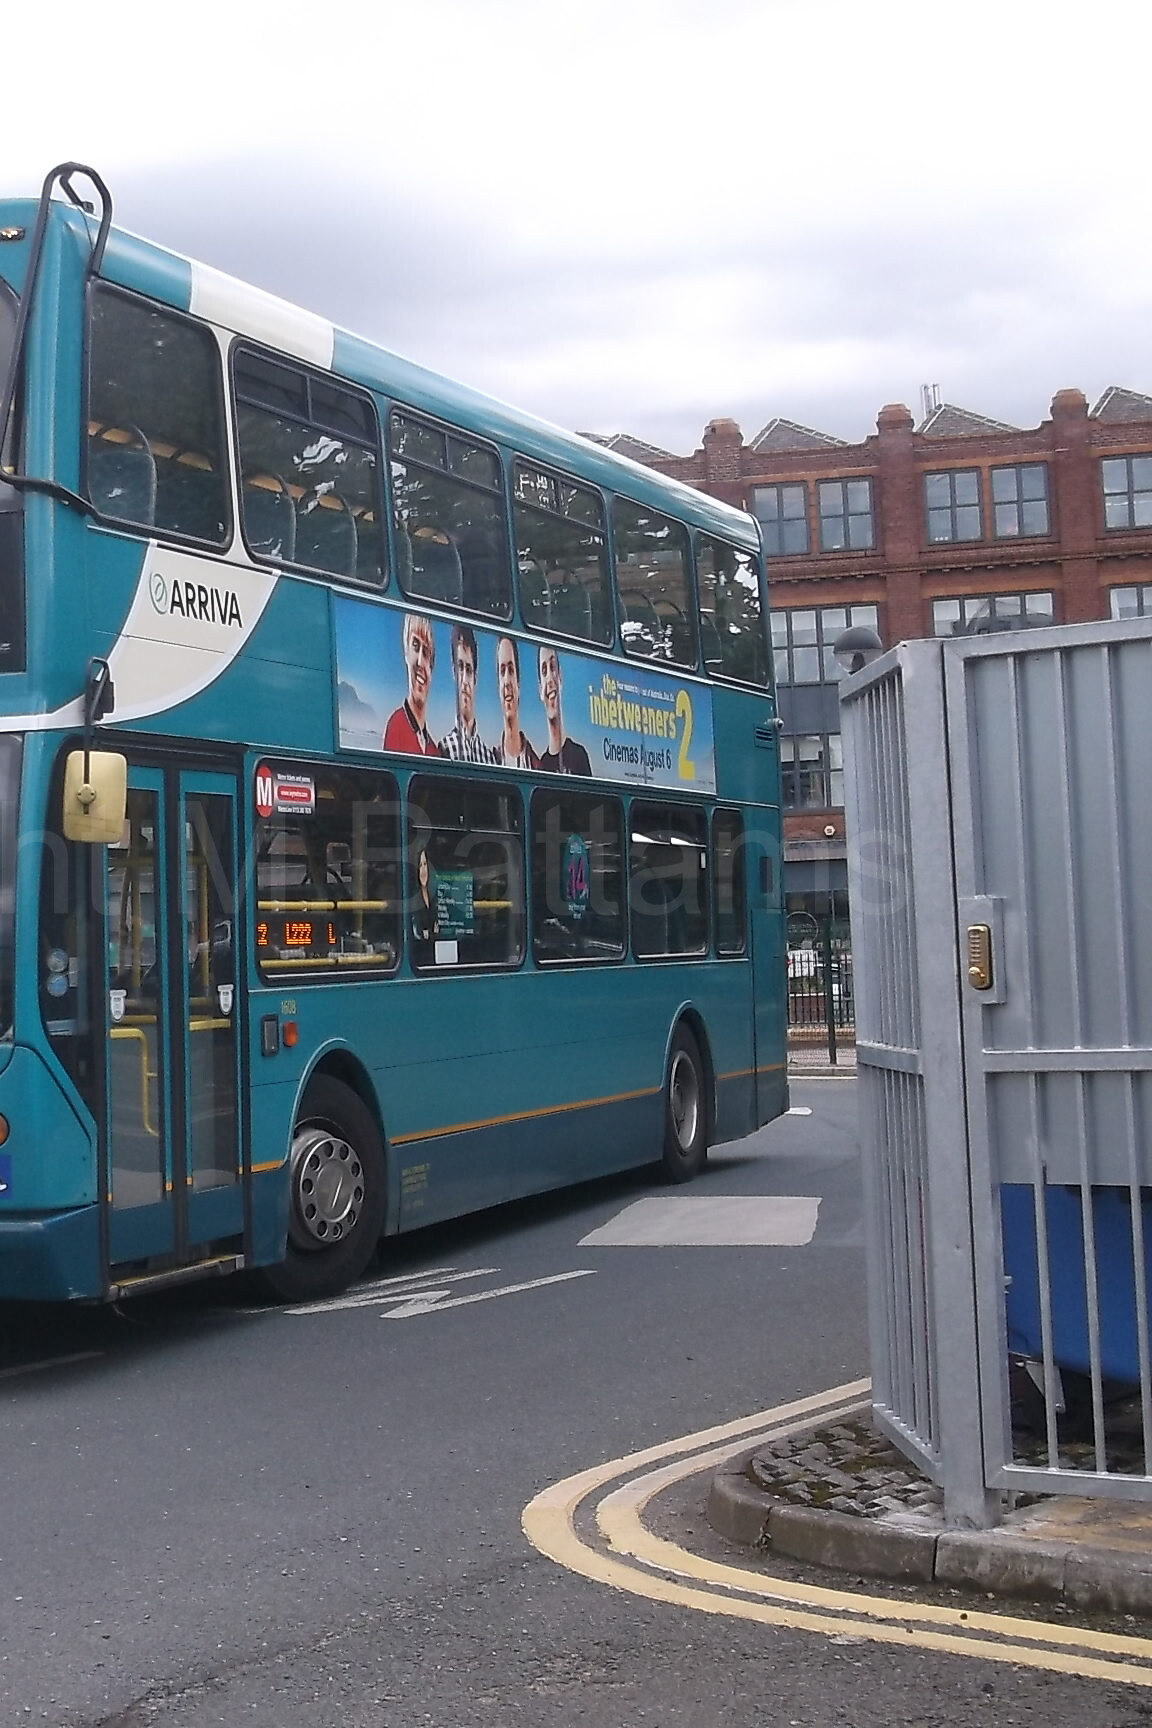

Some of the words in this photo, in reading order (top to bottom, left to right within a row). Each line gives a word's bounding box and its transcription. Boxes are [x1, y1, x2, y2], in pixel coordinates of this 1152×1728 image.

[170, 579, 243, 628] ARRIVA
[602, 673, 617, 697] the
[588, 684, 677, 740] inbetweeners
[675, 689, 695, 780] 2
[602, 737, 639, 765] Cinemas
[640, 743, 665, 772] August
[665, 748, 672, 770] 6
[256, 776, 272, 807] M
